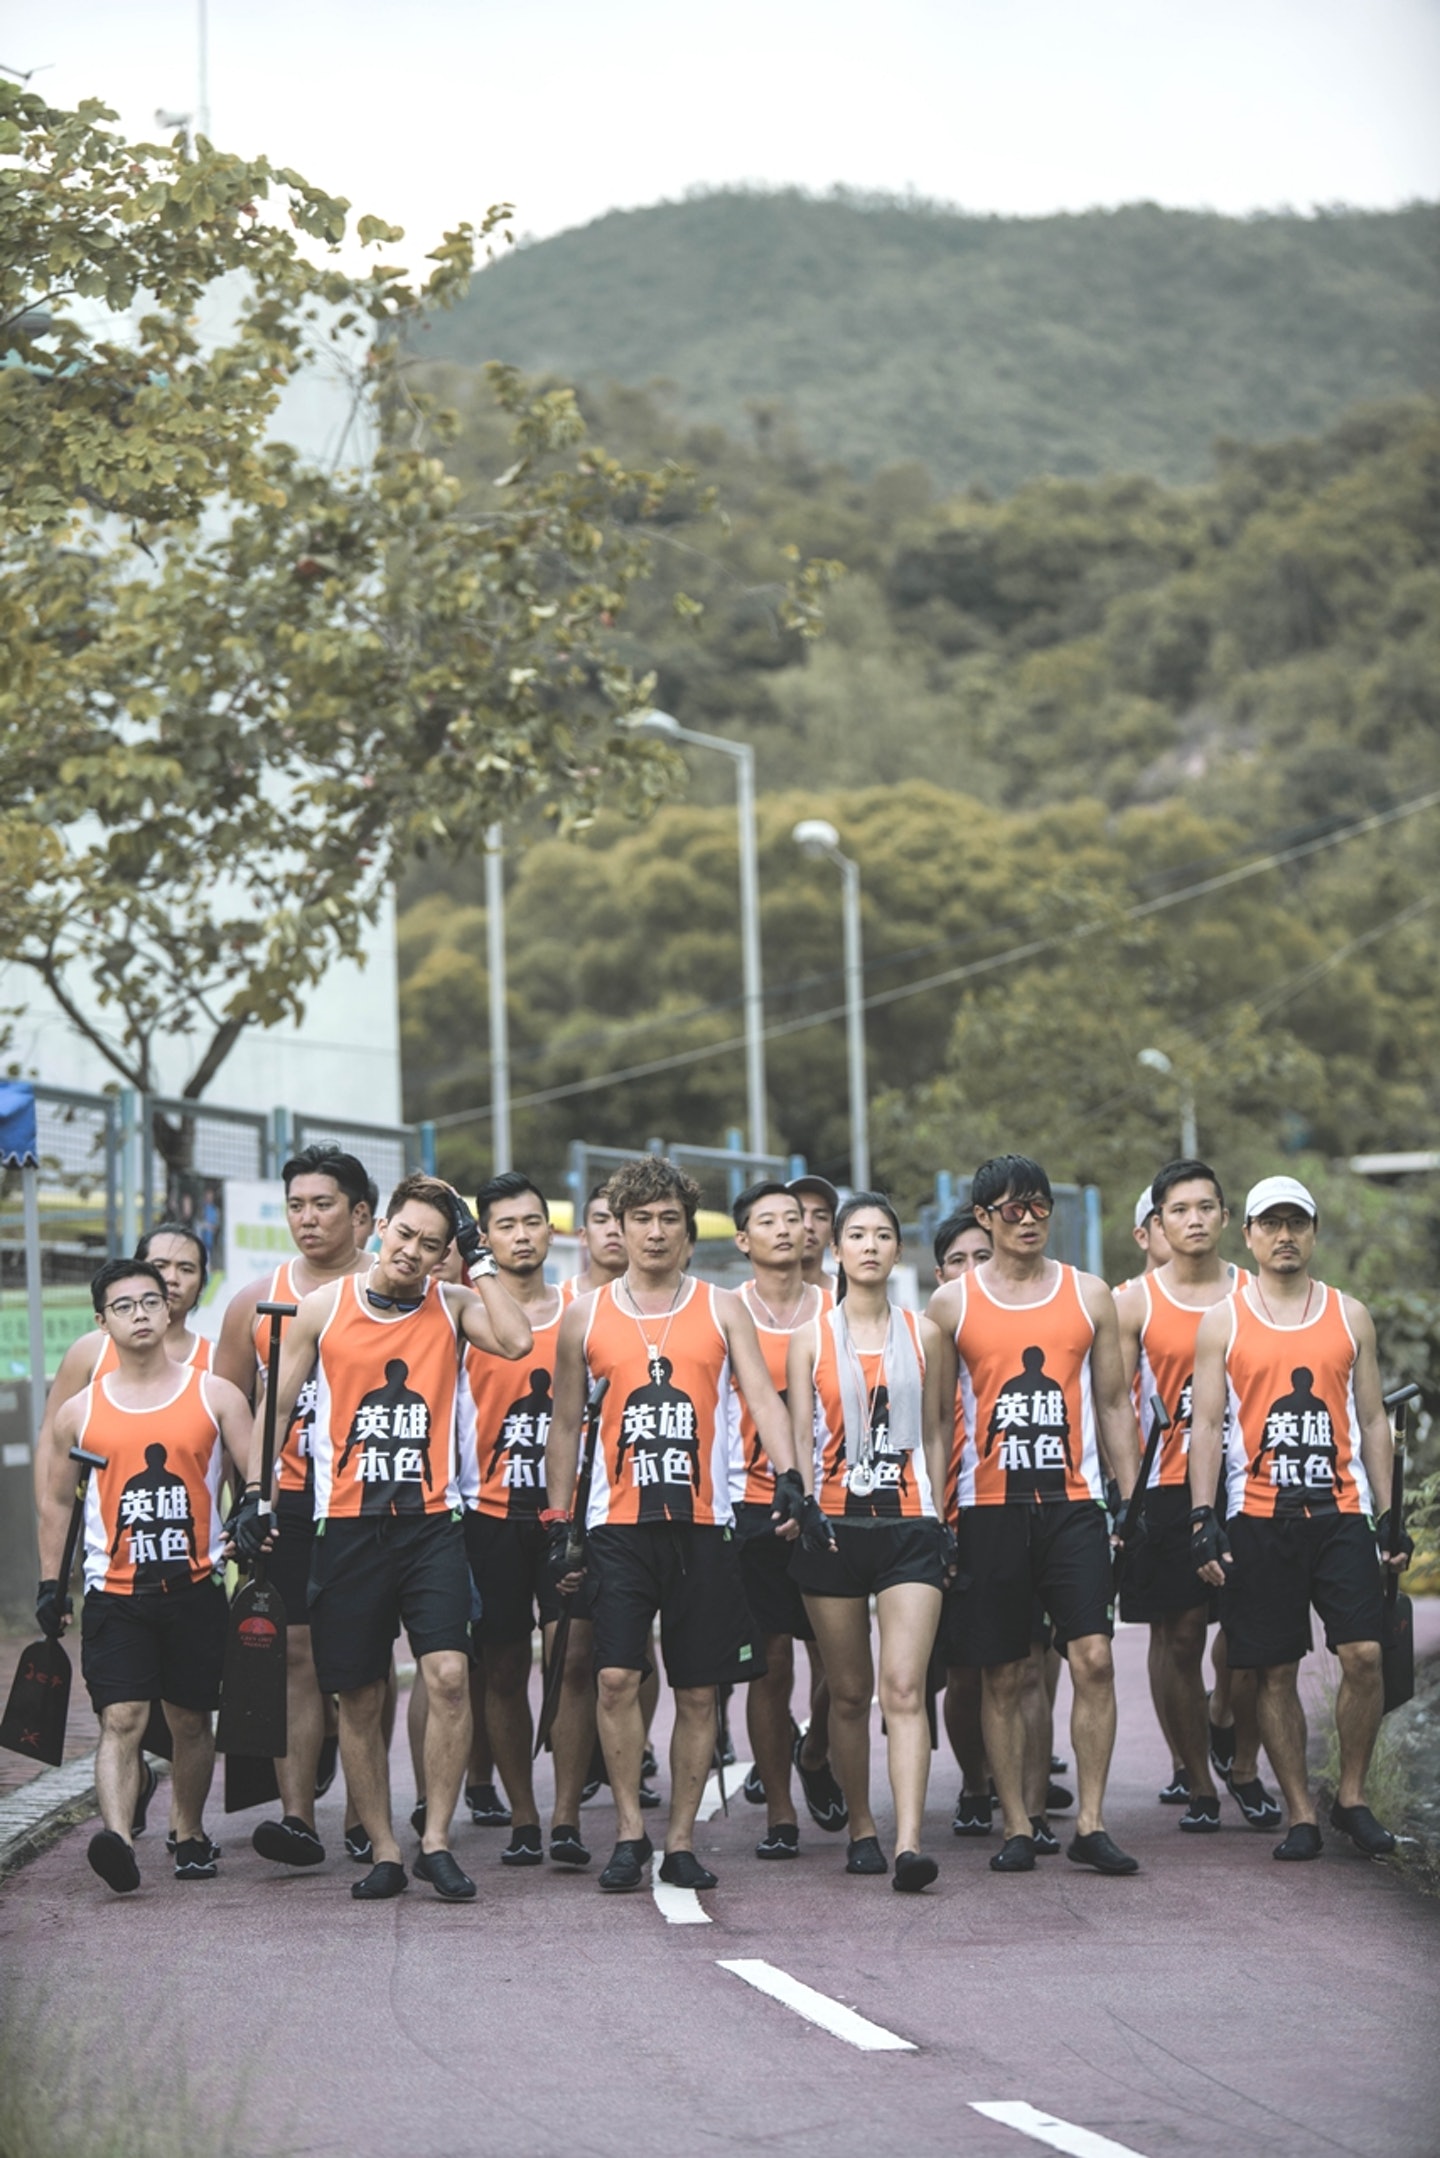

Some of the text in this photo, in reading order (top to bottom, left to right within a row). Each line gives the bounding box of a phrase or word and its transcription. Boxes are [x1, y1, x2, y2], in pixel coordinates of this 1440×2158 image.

[356, 1403, 428, 1440] 英雄
[622, 1401, 694, 1443] 英雄
[995, 1390, 1064, 1430] 英雄
[1266, 1410, 1332, 1448] 英雄
[354, 1446, 424, 1482] 本色
[501, 1453, 547, 1488] 本
[628, 1447, 692, 1487] 本色
[997, 1433, 1066, 1470] 本色
[1267, 1453, 1334, 1488] 本色
[120, 1485, 188, 1525] 英雄
[126, 1527, 190, 1565] 本色
